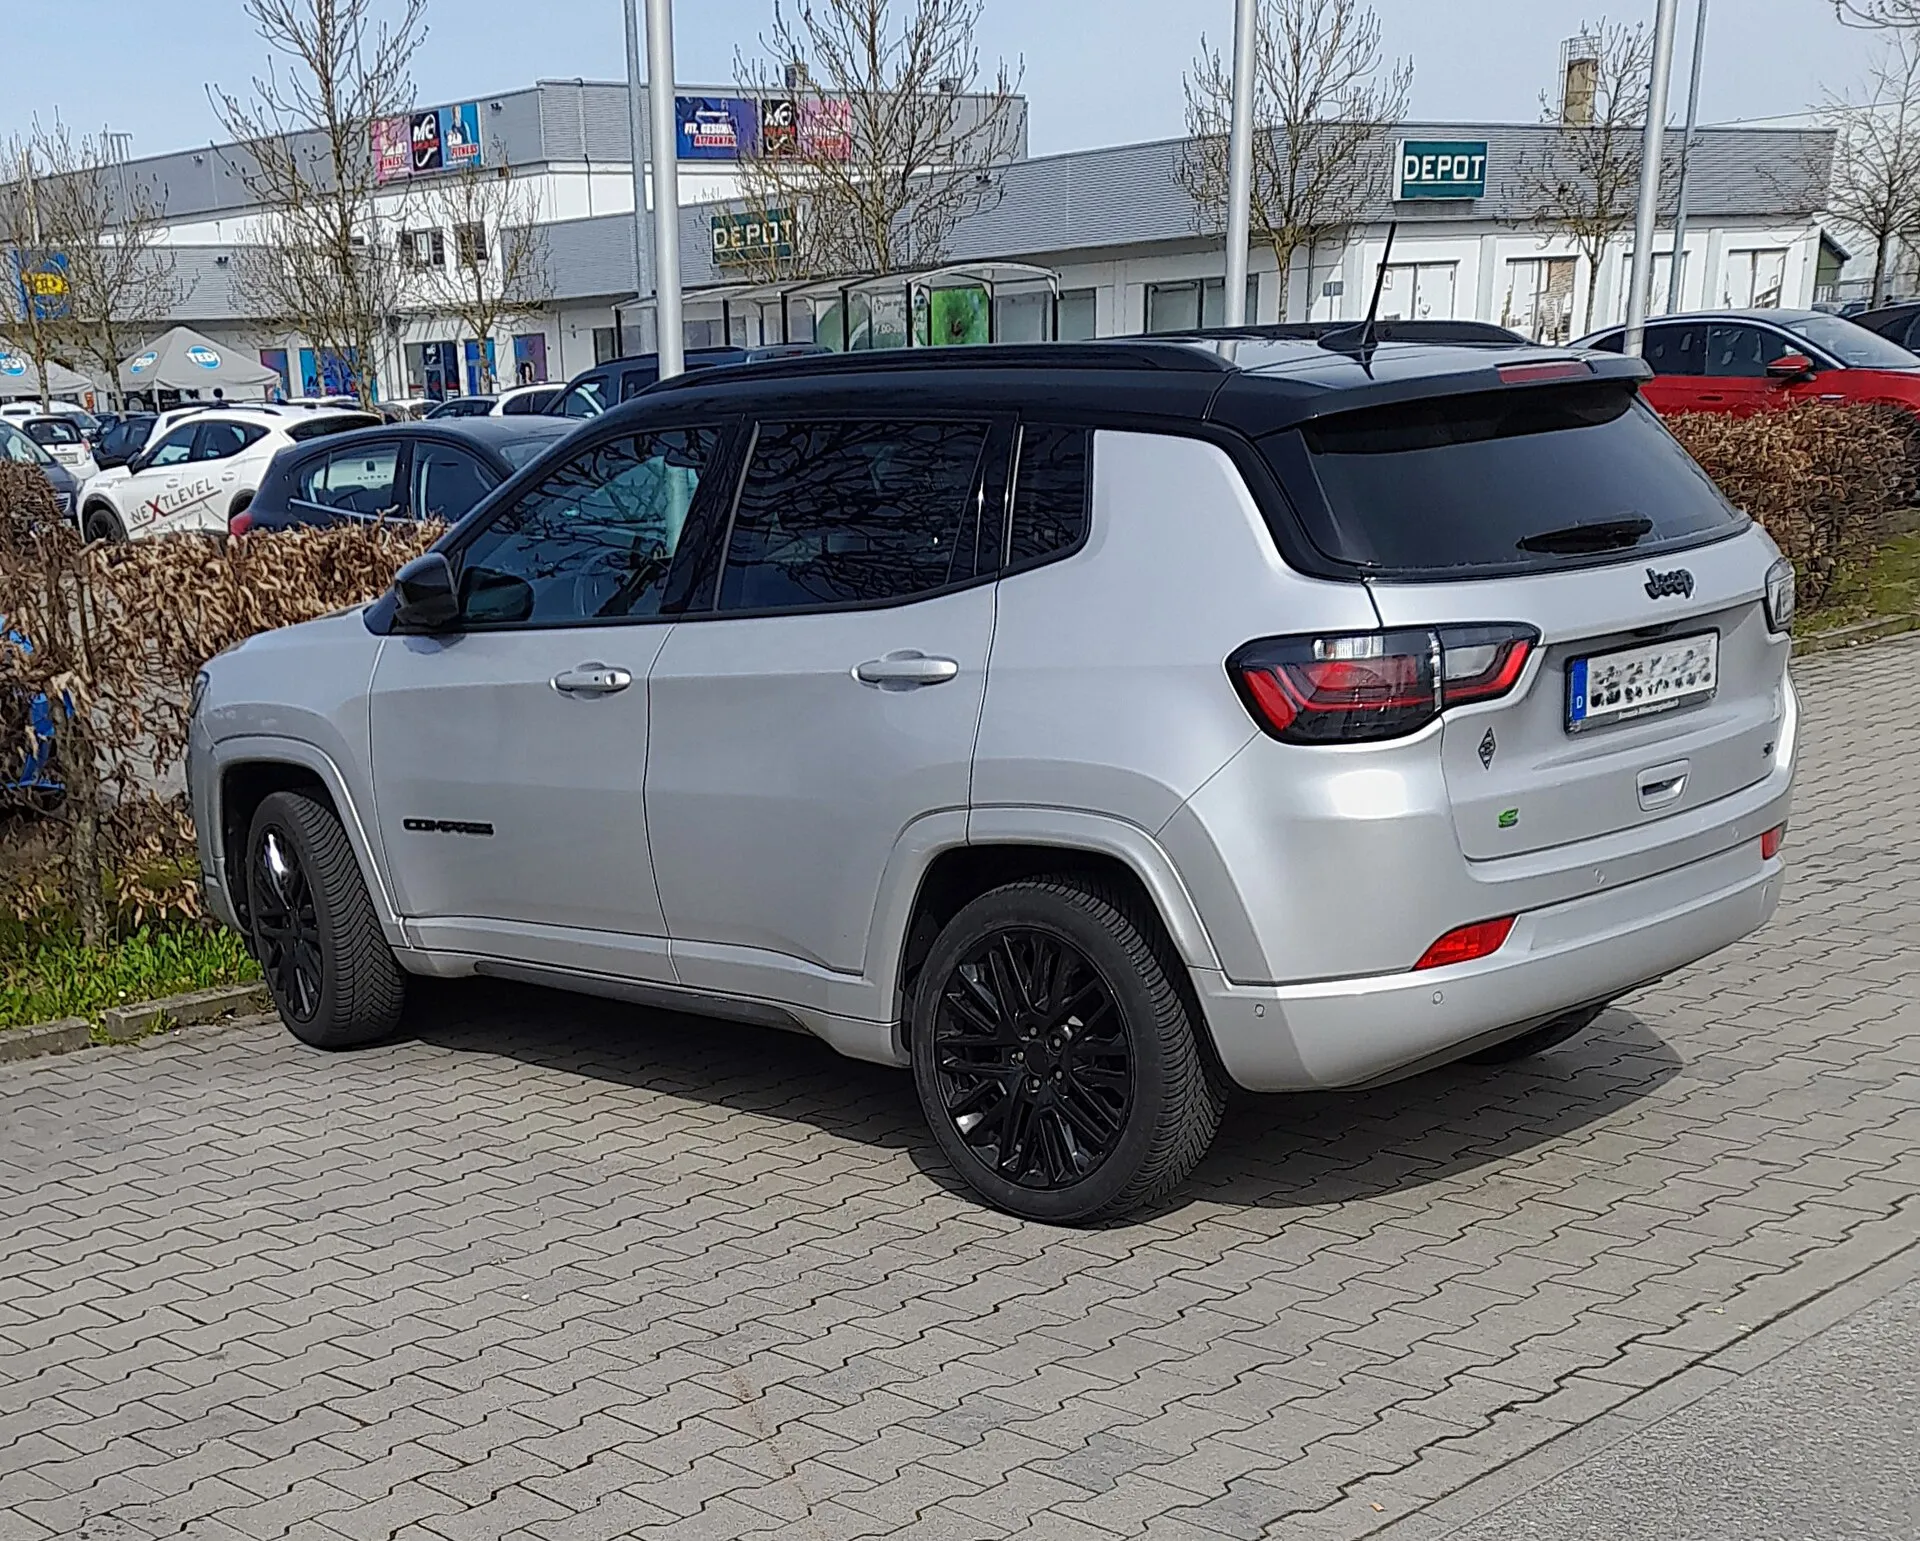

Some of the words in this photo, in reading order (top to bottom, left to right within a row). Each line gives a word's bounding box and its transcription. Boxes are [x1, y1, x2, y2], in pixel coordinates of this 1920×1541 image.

[1403, 154, 1486, 181] DEPOT
[713, 219, 792, 249] DEPOT
[1644, 567, 1696, 600] Jeep
[1576, 695, 1584, 709] D
